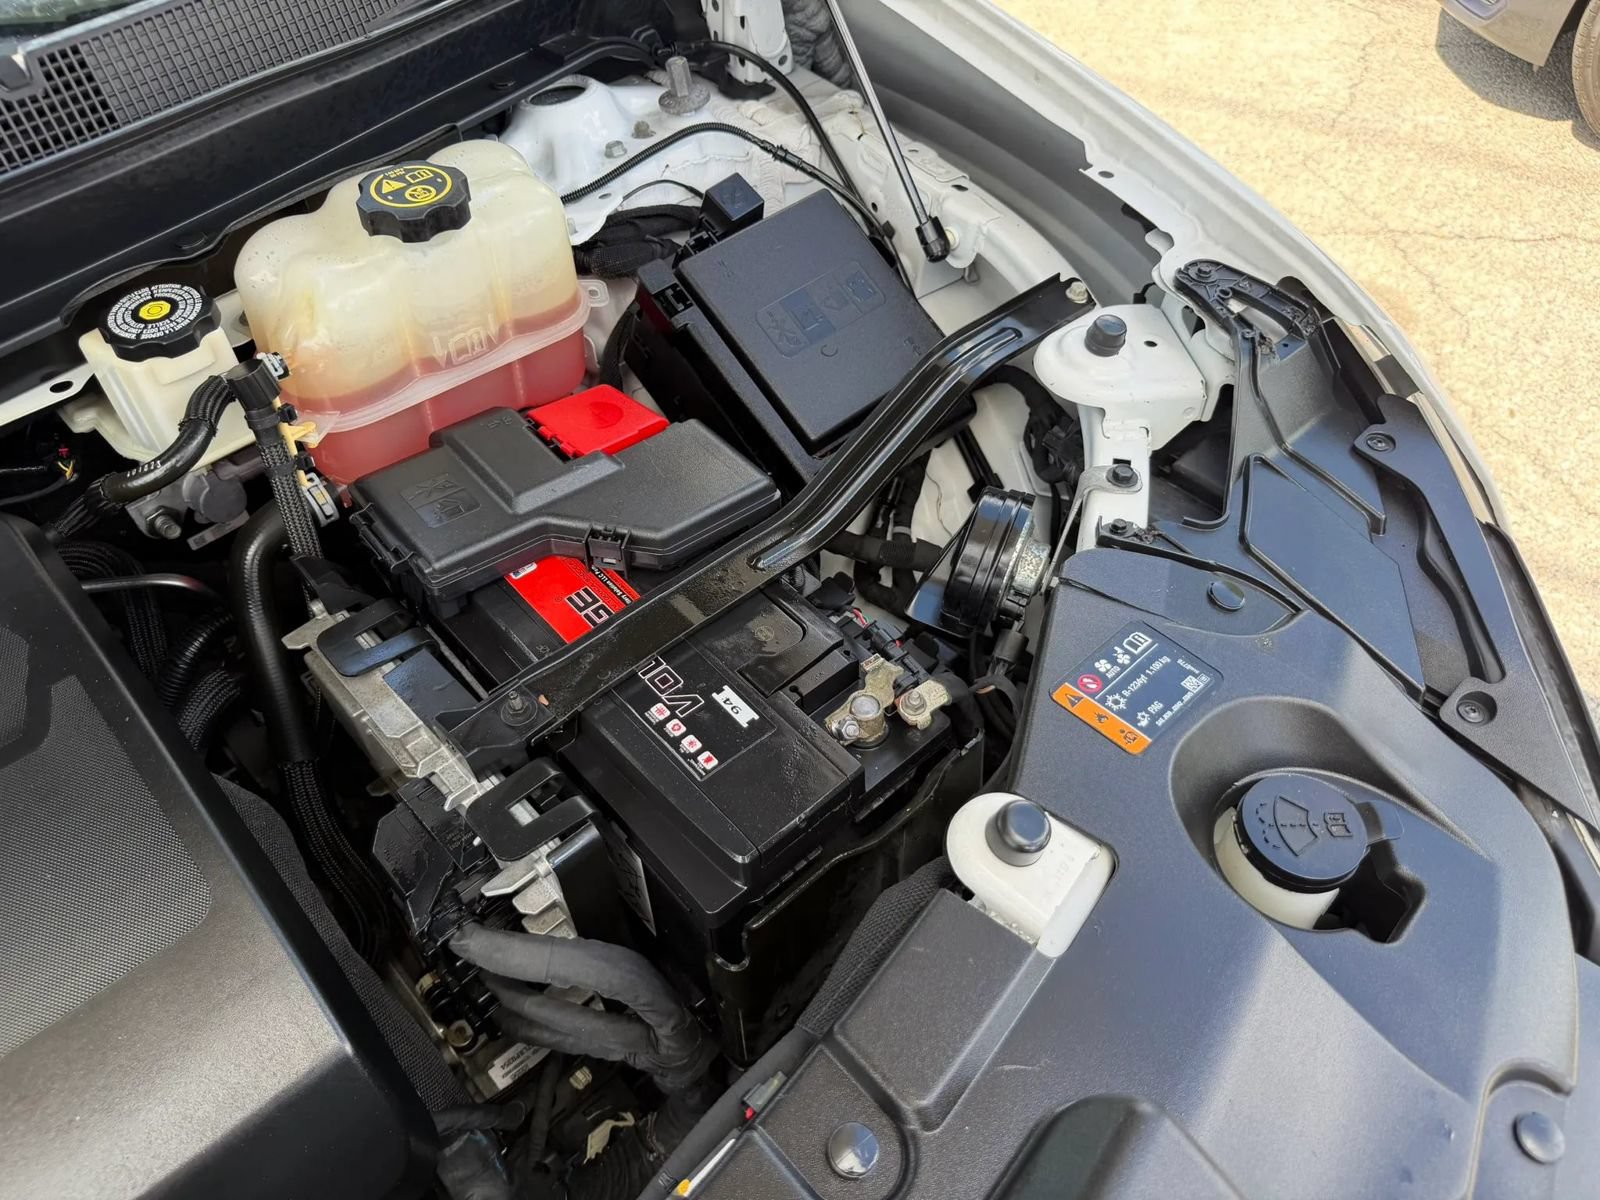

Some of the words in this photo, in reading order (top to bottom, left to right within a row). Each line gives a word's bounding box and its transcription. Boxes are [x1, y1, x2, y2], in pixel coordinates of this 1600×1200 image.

[597, 572, 608, 582] LLC
[1105, 664, 1120, 678] AUTO
[1145, 660, 1163, 674] 1.100
[1159, 655, 1170, 663] kg
[1147, 700, 1163, 713] PAG
